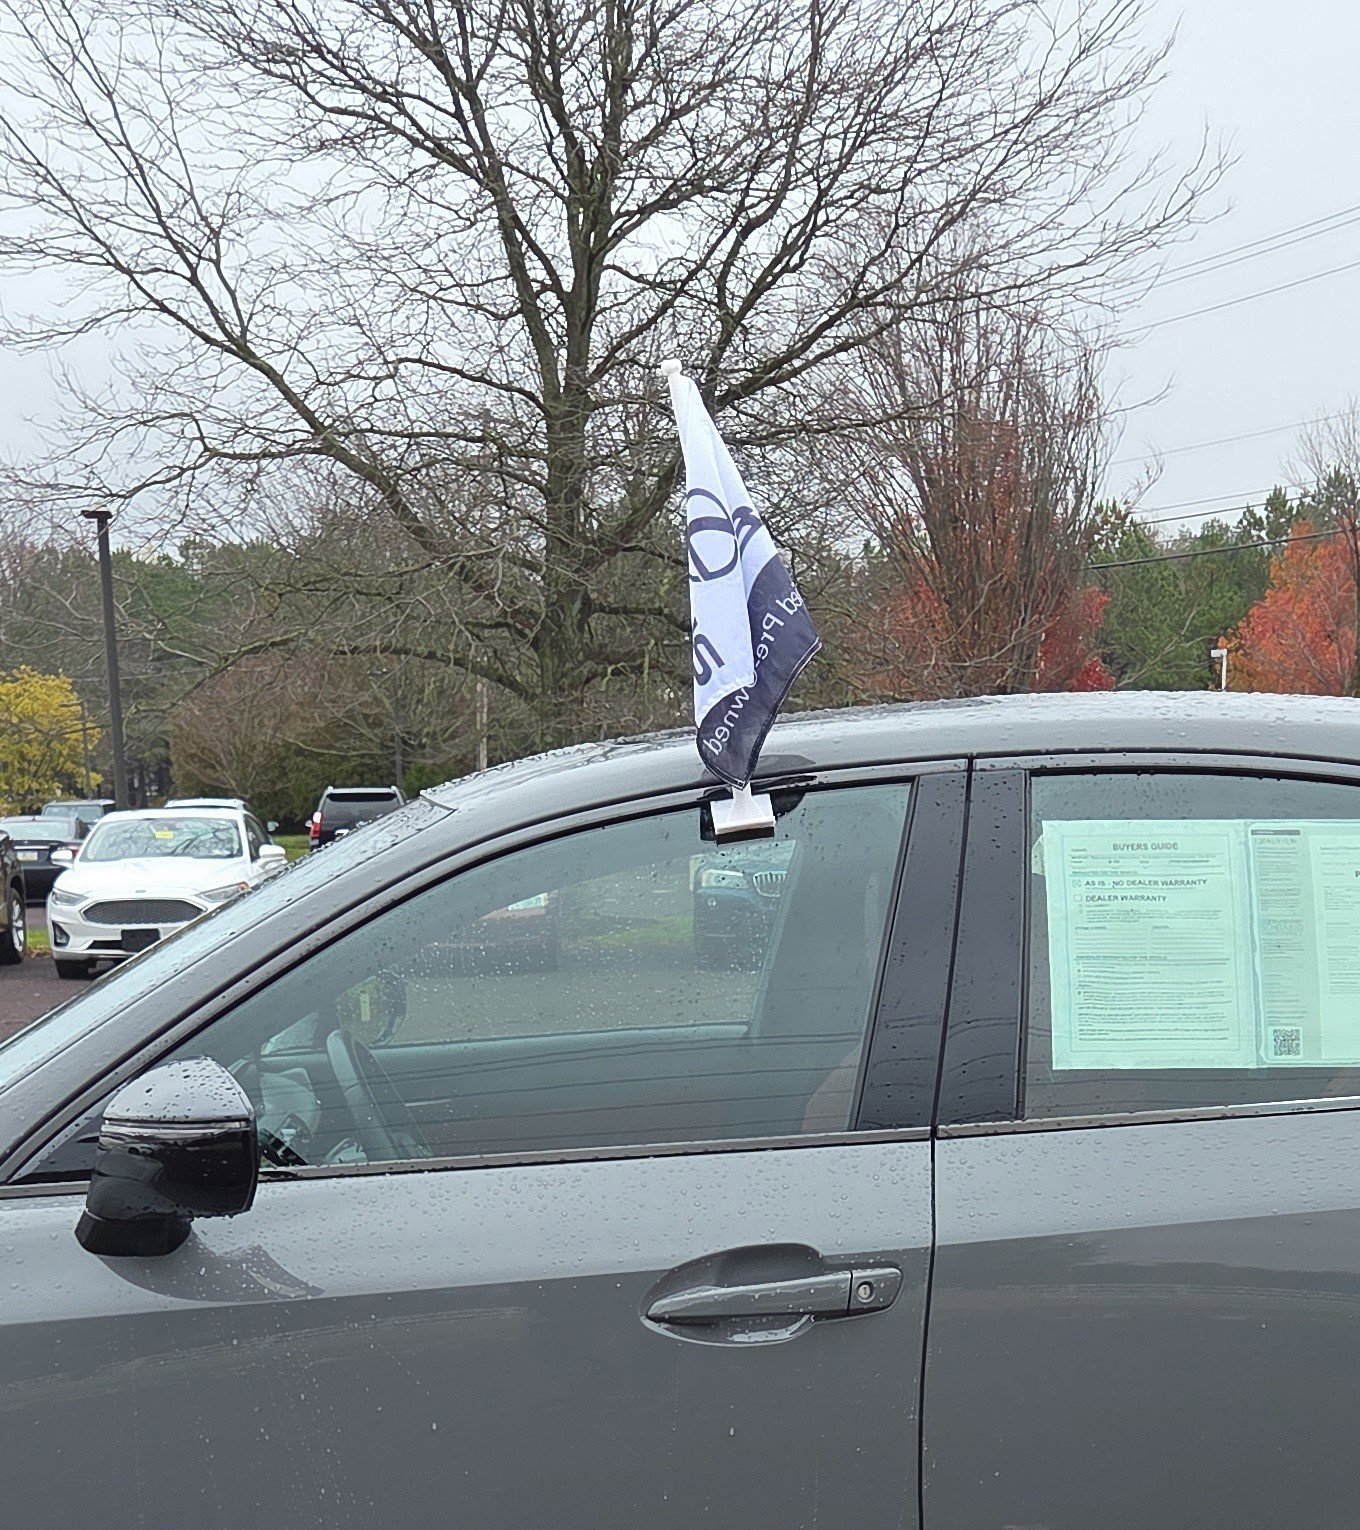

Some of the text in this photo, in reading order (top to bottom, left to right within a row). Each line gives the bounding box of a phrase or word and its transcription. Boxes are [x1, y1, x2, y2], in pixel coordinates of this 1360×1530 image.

[1112, 842, 1179, 851] BUYERS GUIDE
[1161, 878, 1208, 886] WARRANTY
[1120, 894, 1167, 902] WARRANTY
